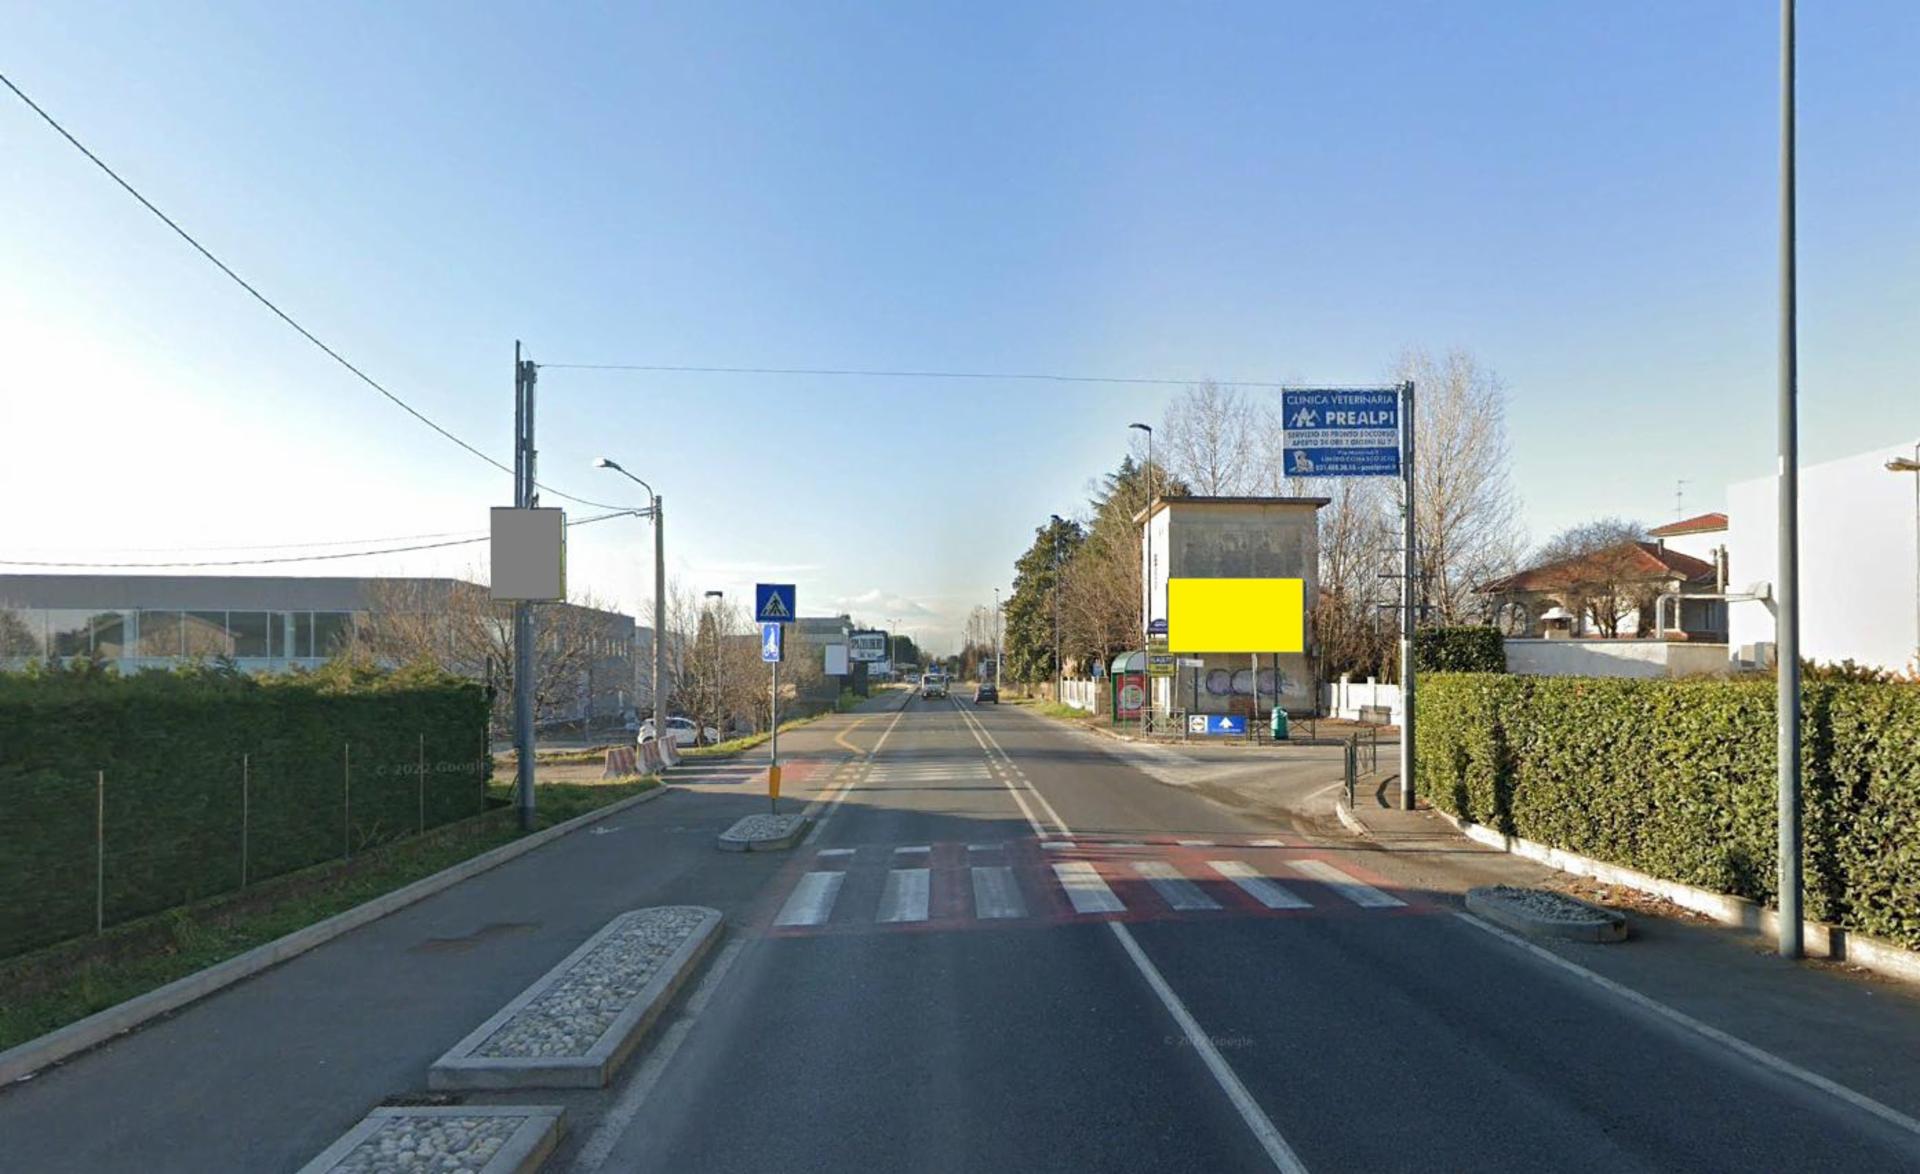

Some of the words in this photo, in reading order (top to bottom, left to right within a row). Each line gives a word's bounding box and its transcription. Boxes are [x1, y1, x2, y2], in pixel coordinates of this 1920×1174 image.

[1287, 395, 1328, 405] CLINICA
[1331, 395, 1393, 405] VETERINARIA
[1325, 411, 1394, 425] PREALPI
